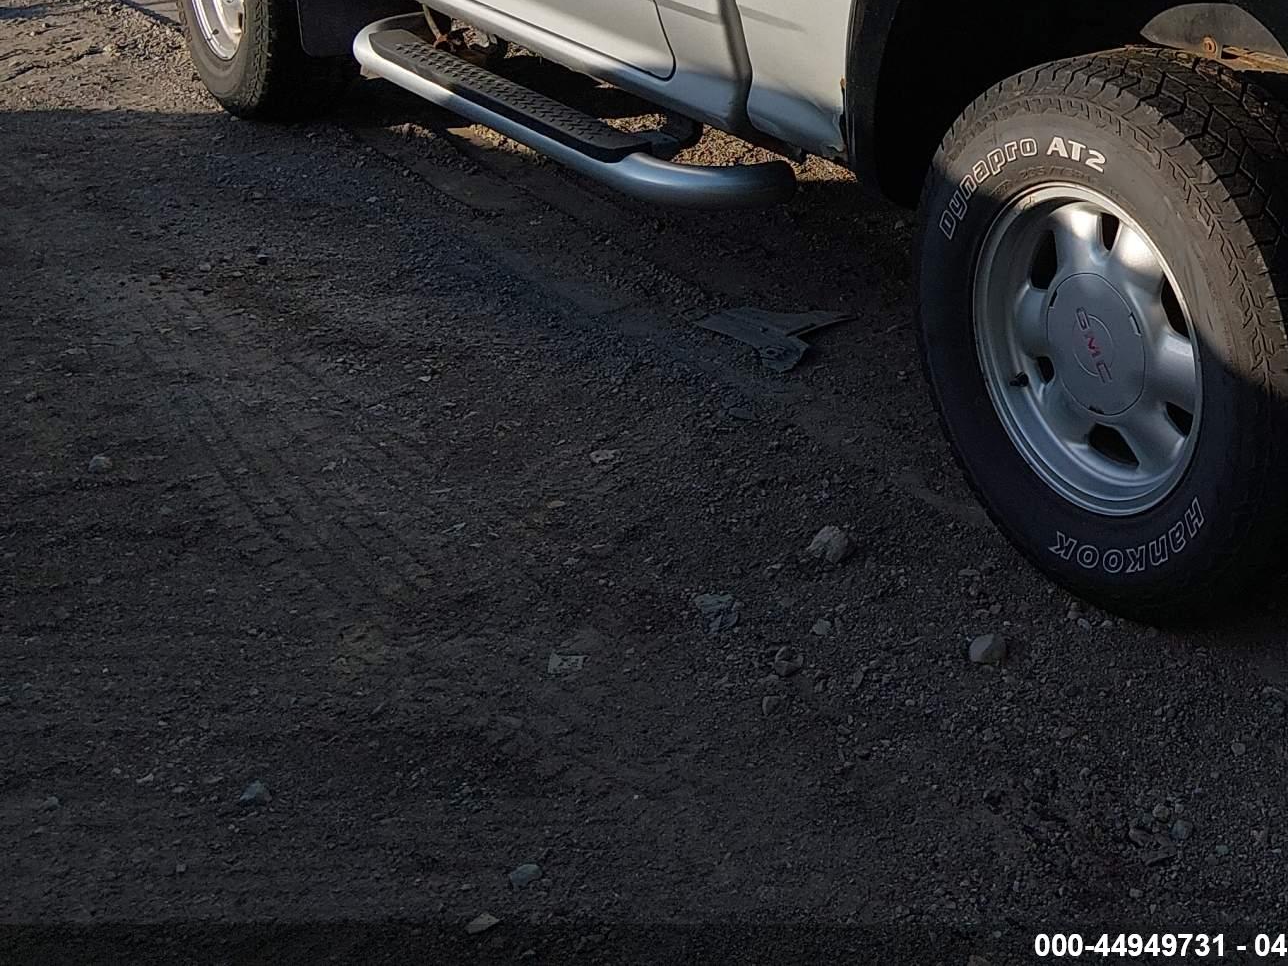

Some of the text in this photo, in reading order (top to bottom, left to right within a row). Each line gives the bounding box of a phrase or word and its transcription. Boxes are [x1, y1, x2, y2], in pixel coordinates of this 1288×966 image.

[939, 136, 1107, 240] Dynapro AT2
[1076, 306, 1113, 384] GMC
